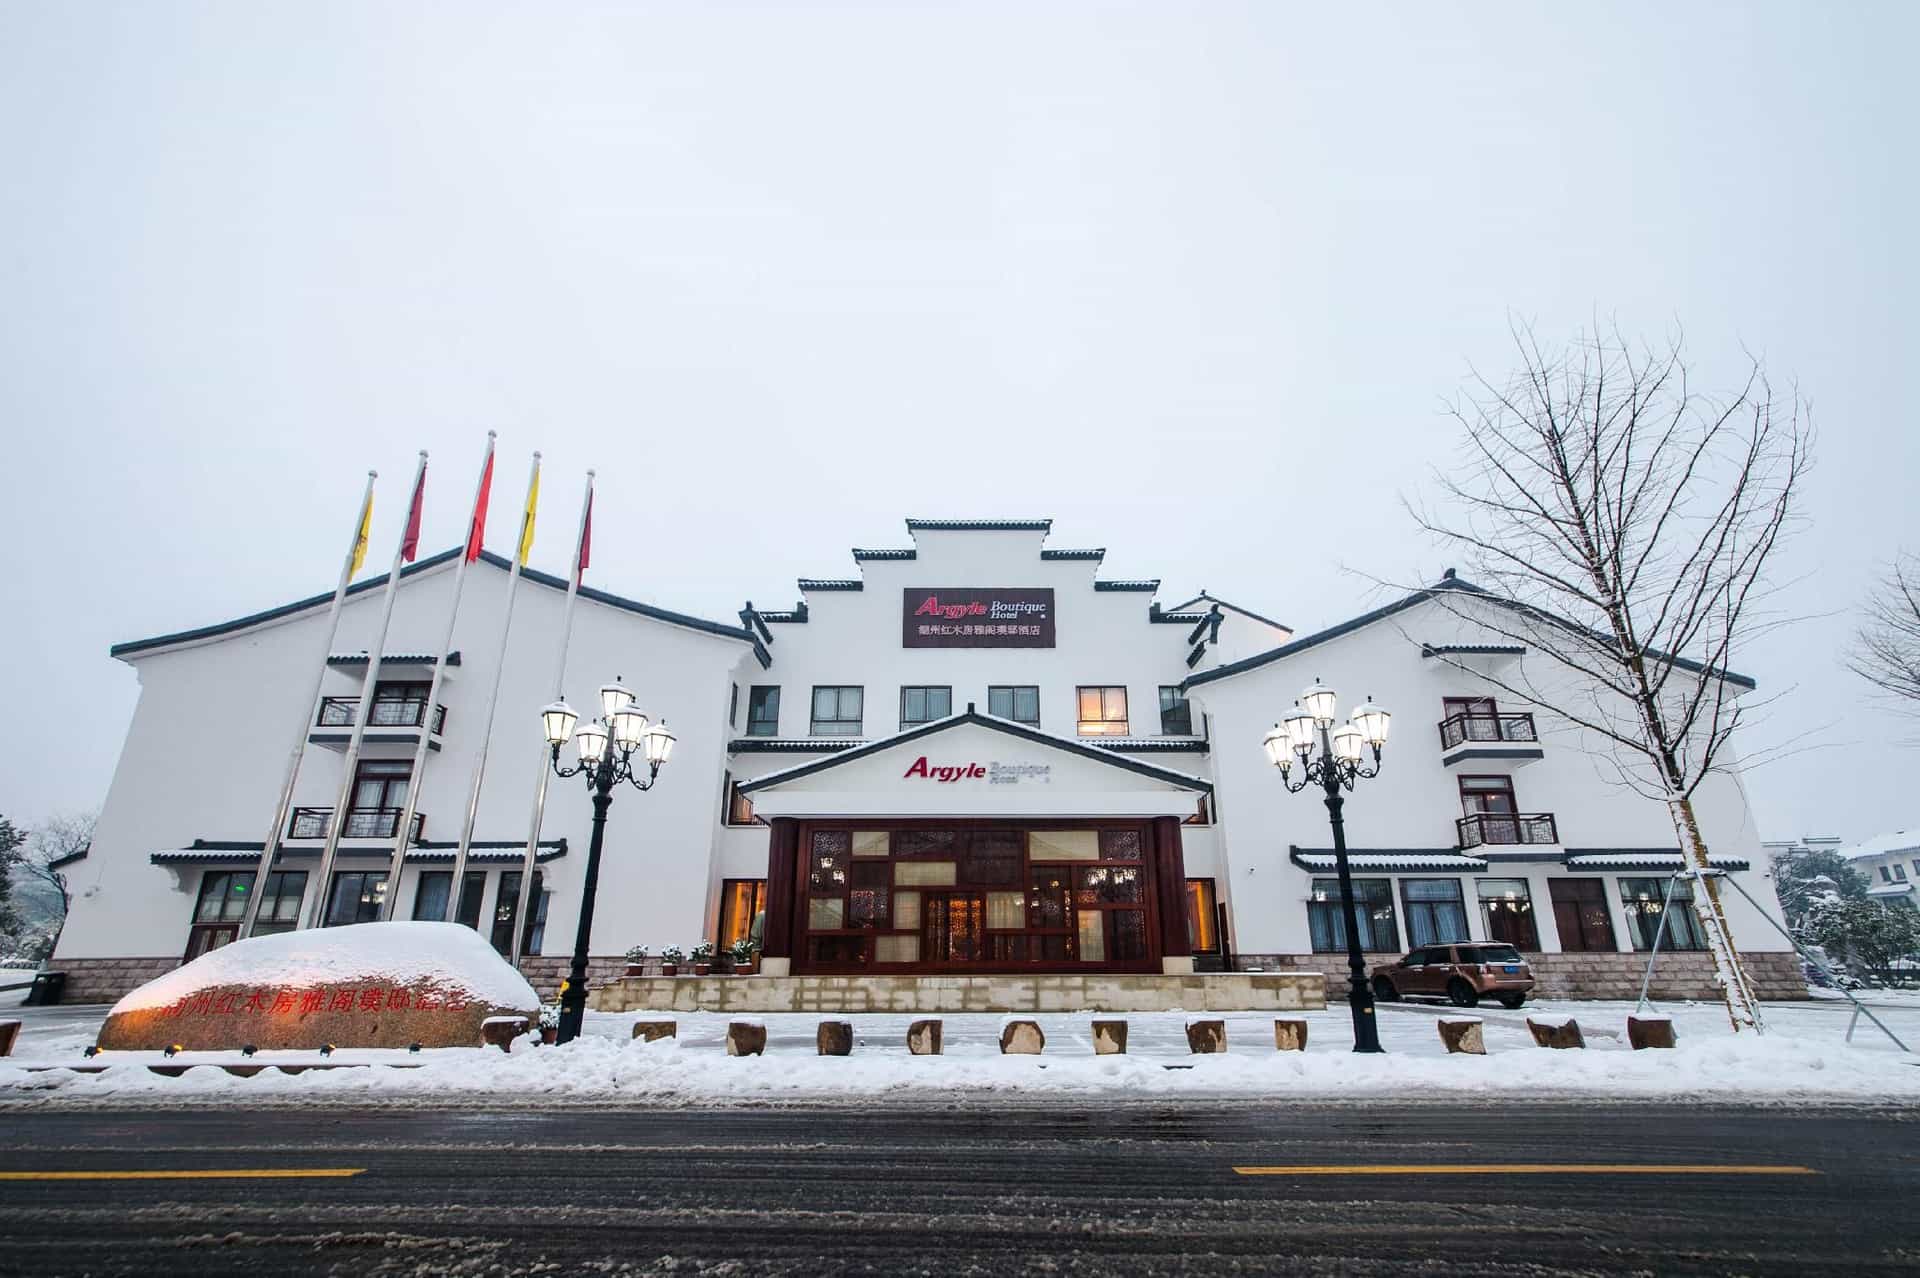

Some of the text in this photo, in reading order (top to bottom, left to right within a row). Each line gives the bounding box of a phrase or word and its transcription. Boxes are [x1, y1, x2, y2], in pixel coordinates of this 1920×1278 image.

[914, 593, 1047, 619] Argyle Boutique
[990, 610, 1018, 620] Hotel
[903, 756, 1050, 783] Argyle Boutique
